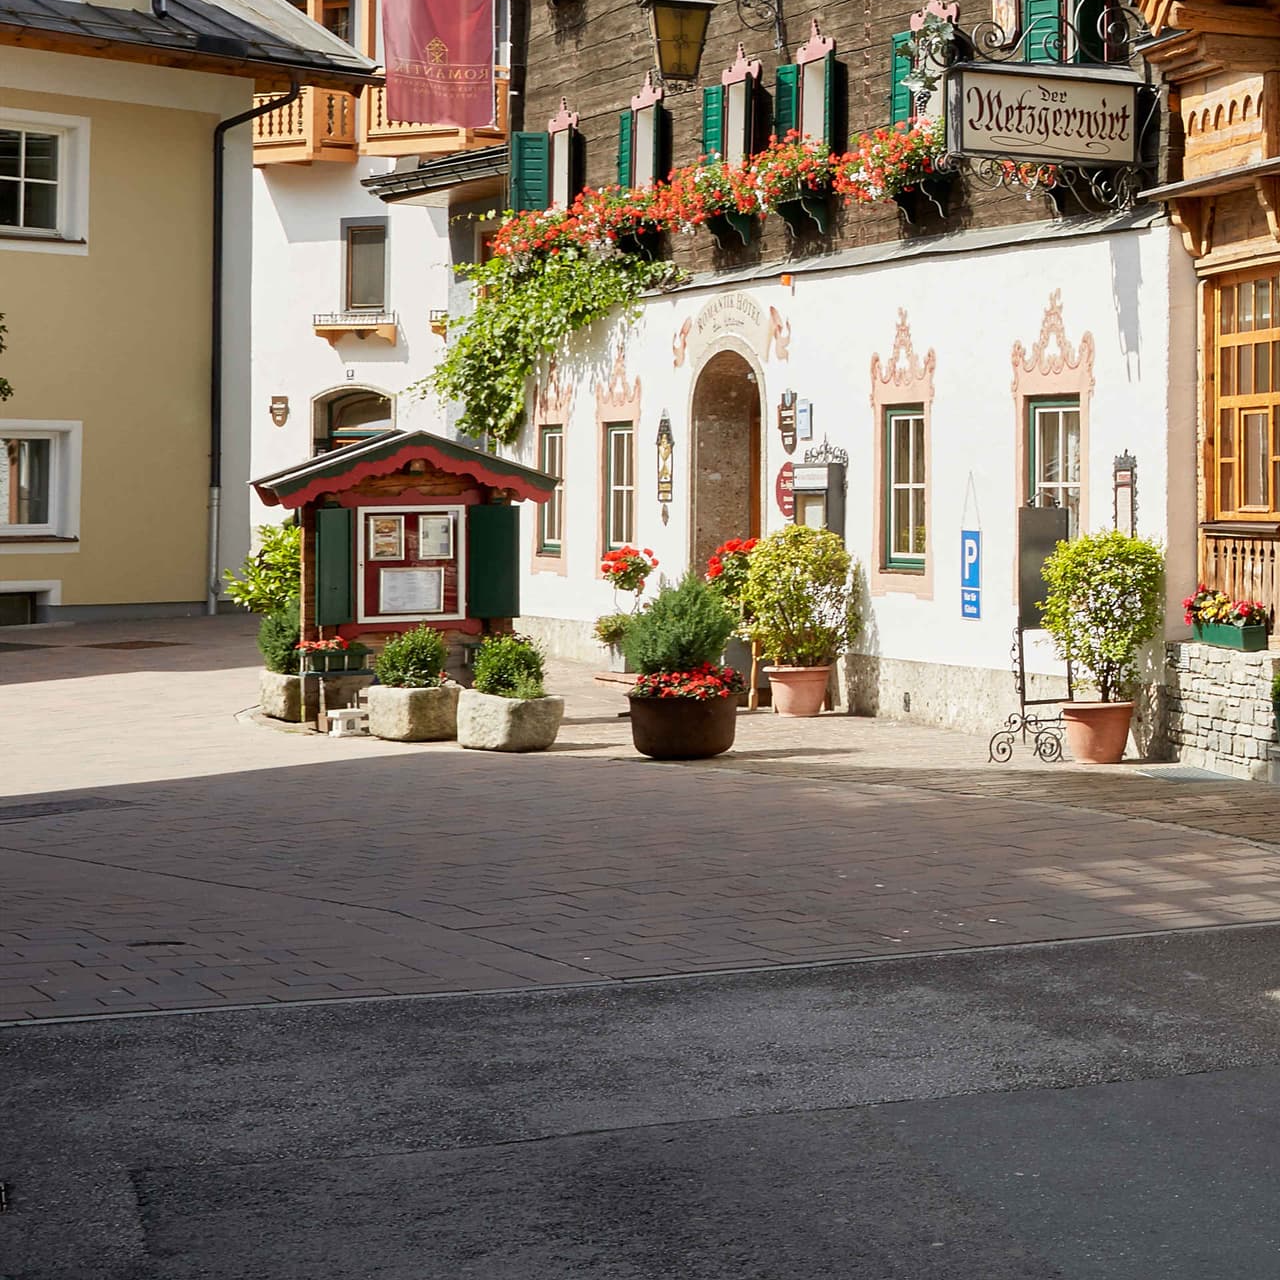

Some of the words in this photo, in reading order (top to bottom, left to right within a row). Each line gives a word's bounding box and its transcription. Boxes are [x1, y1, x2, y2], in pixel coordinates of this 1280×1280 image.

[1038, 84, 1067, 103] Der
[966, 87, 1131, 144] Metzgerwirt
[964, 539, 978, 580] P
